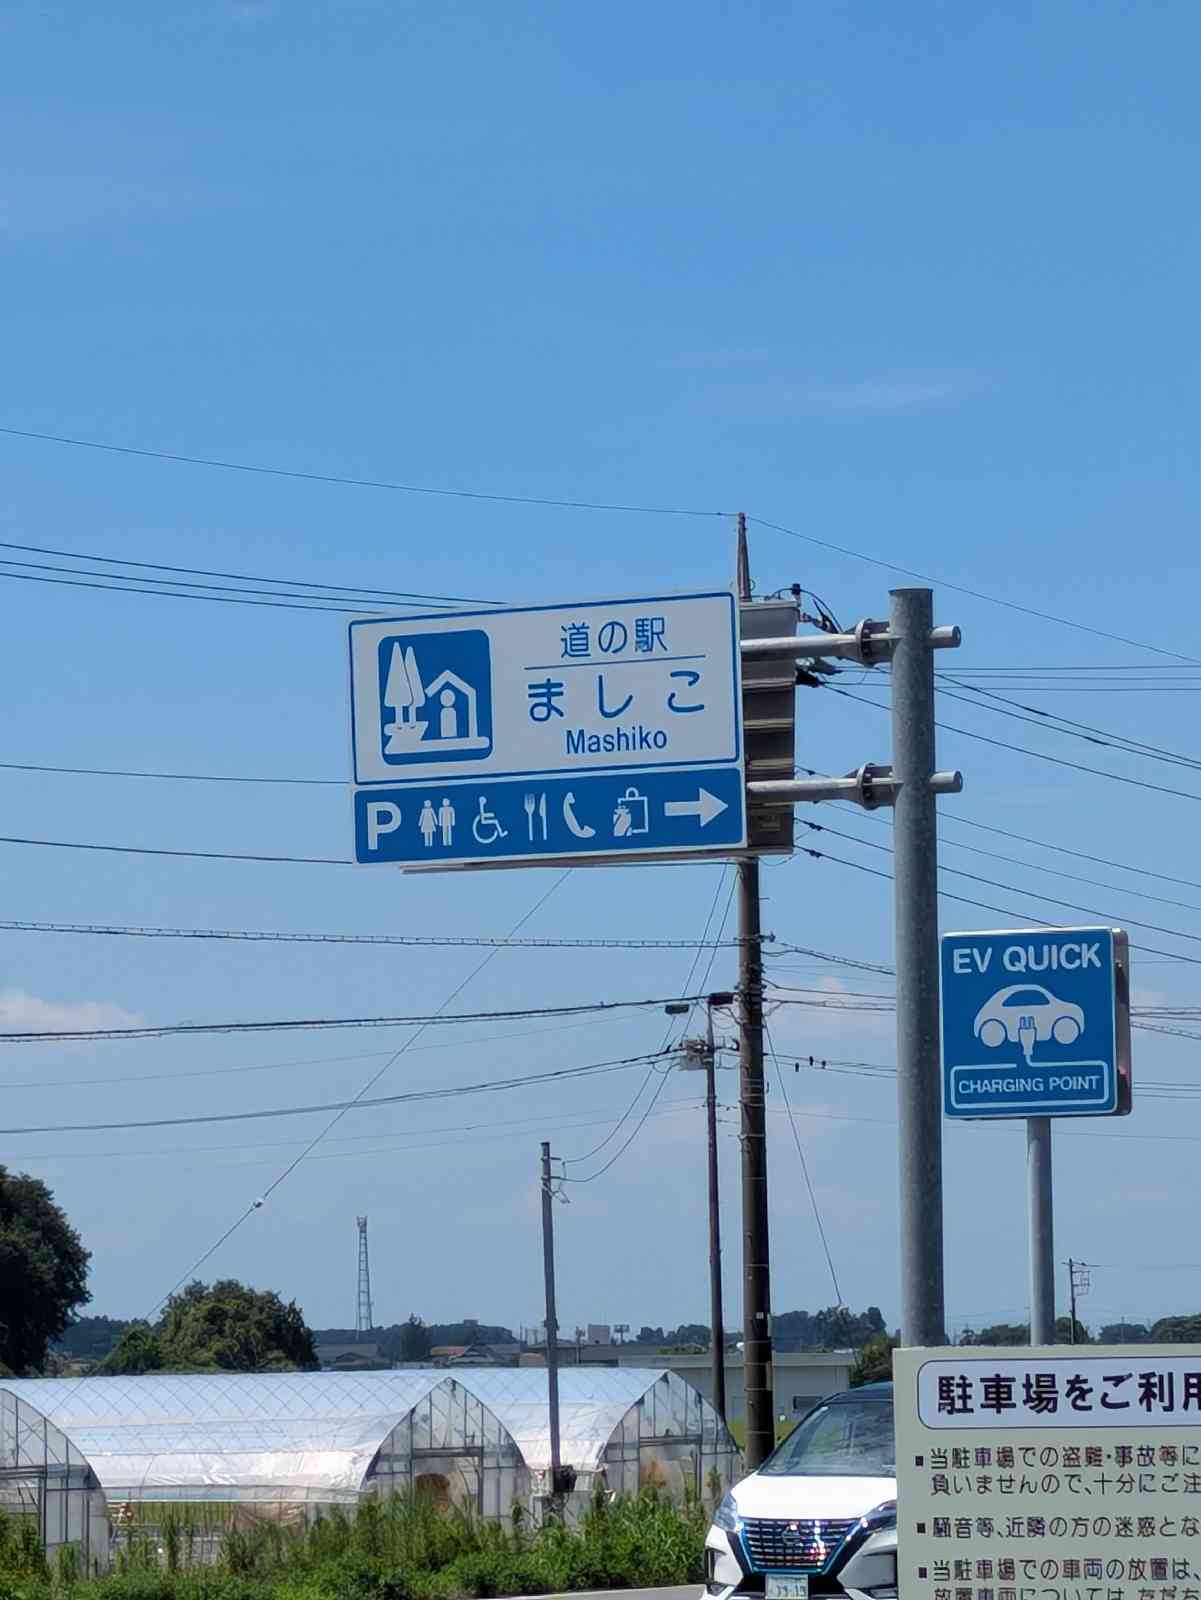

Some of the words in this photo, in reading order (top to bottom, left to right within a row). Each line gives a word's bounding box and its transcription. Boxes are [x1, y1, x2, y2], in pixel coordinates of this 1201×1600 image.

[560, 616, 668, 657] 道の駅
[527, 669, 705, 722] ましこ
[566, 726, 668, 754] Mashiko
[367, 801, 402, 850] P
[952, 947, 993, 974] EV
[1002, 942, 1102, 973] QUICK
[958, 1077, 1044, 1094] CHARGING
[1048, 1075, 1101, 1091] POINT
